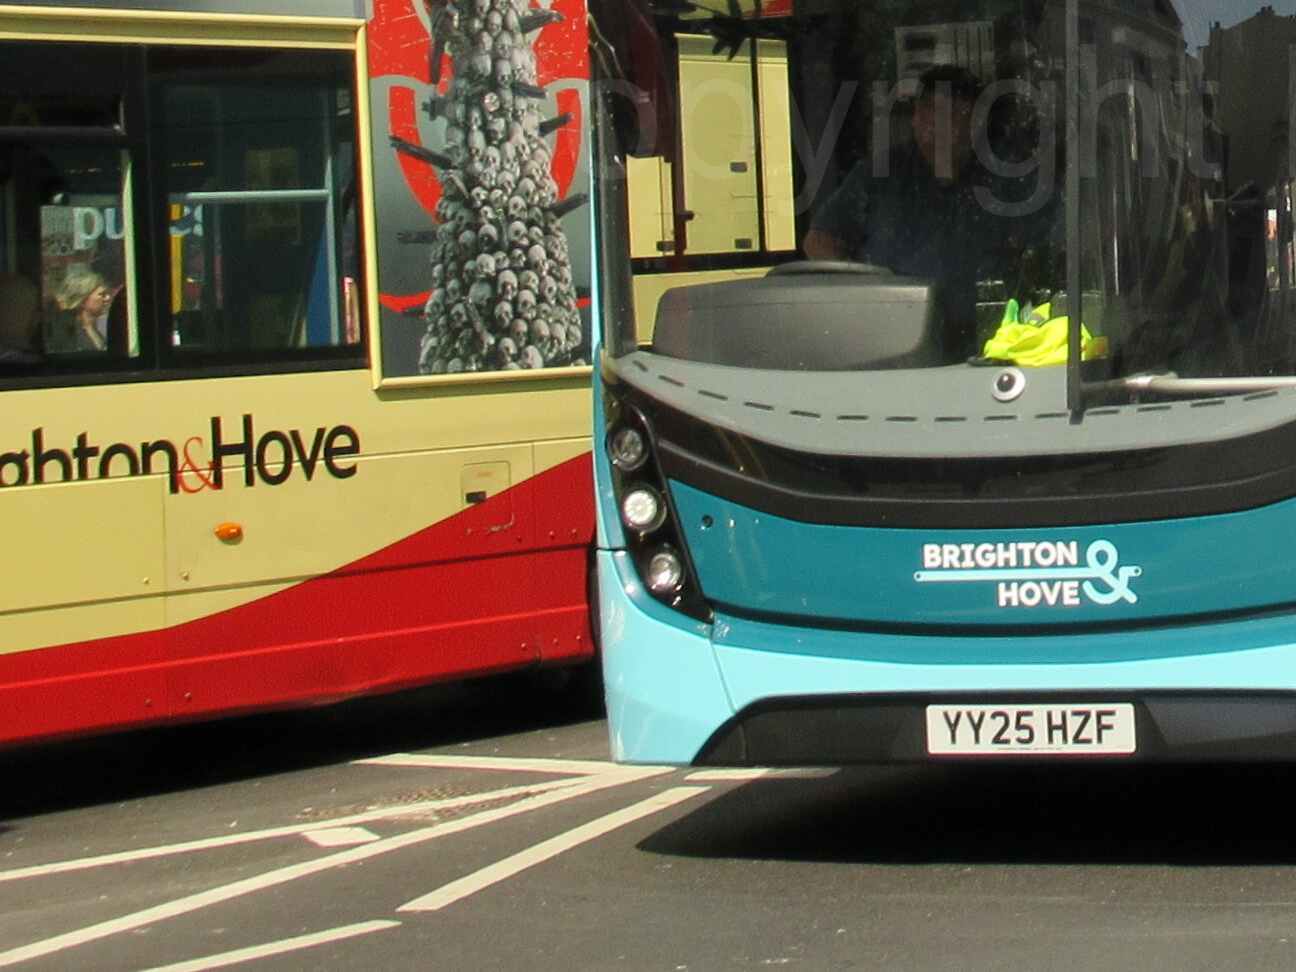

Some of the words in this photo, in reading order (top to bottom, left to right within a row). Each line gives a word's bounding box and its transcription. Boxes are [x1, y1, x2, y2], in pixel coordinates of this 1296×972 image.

[922, 540, 1078, 569] BRIGHTON
[997, 581, 1081, 607] HOVE
[942, 710, 1036, 746] YY25
[1046, 709, 1117, 745] HZF
